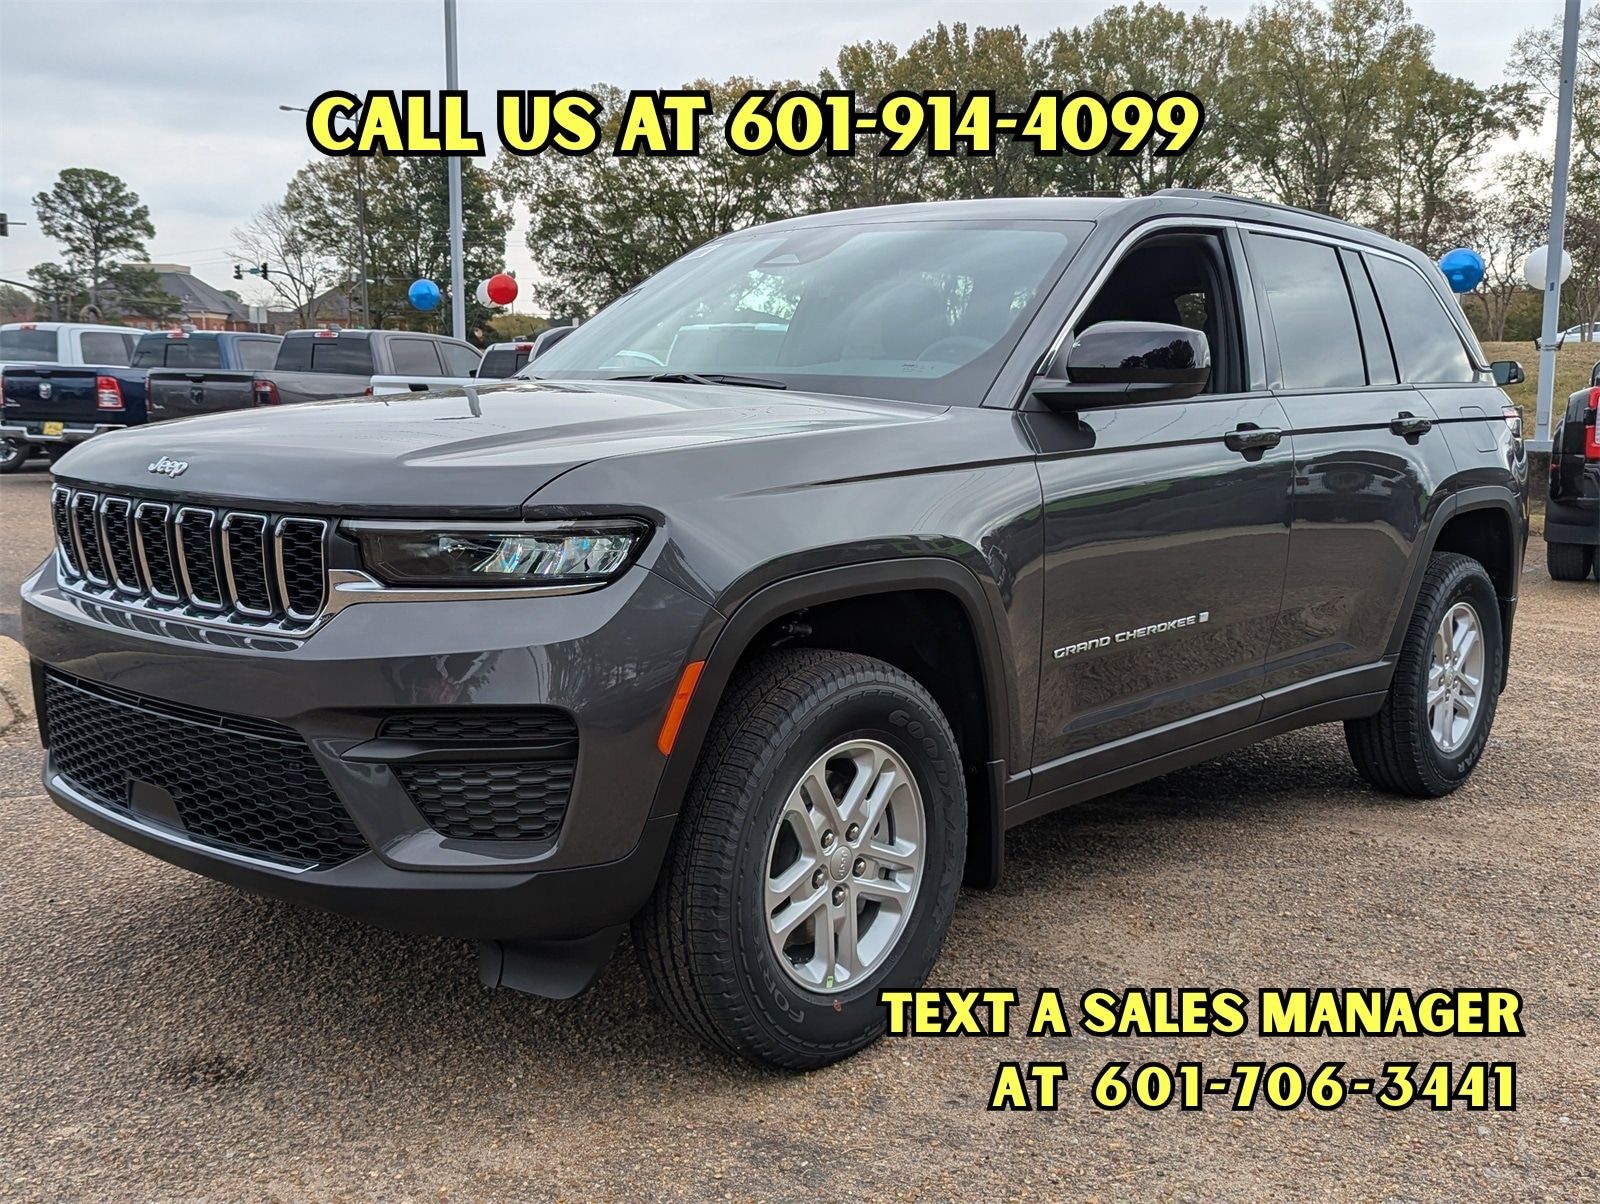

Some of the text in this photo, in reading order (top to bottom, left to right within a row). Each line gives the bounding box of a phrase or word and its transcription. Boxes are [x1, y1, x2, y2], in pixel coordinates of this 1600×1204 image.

[148, 455, 188, 478] Jeep
[1053, 615, 1197, 659] GRAND CHEROKEE
[888, 708, 958, 925] GOODYEAR
